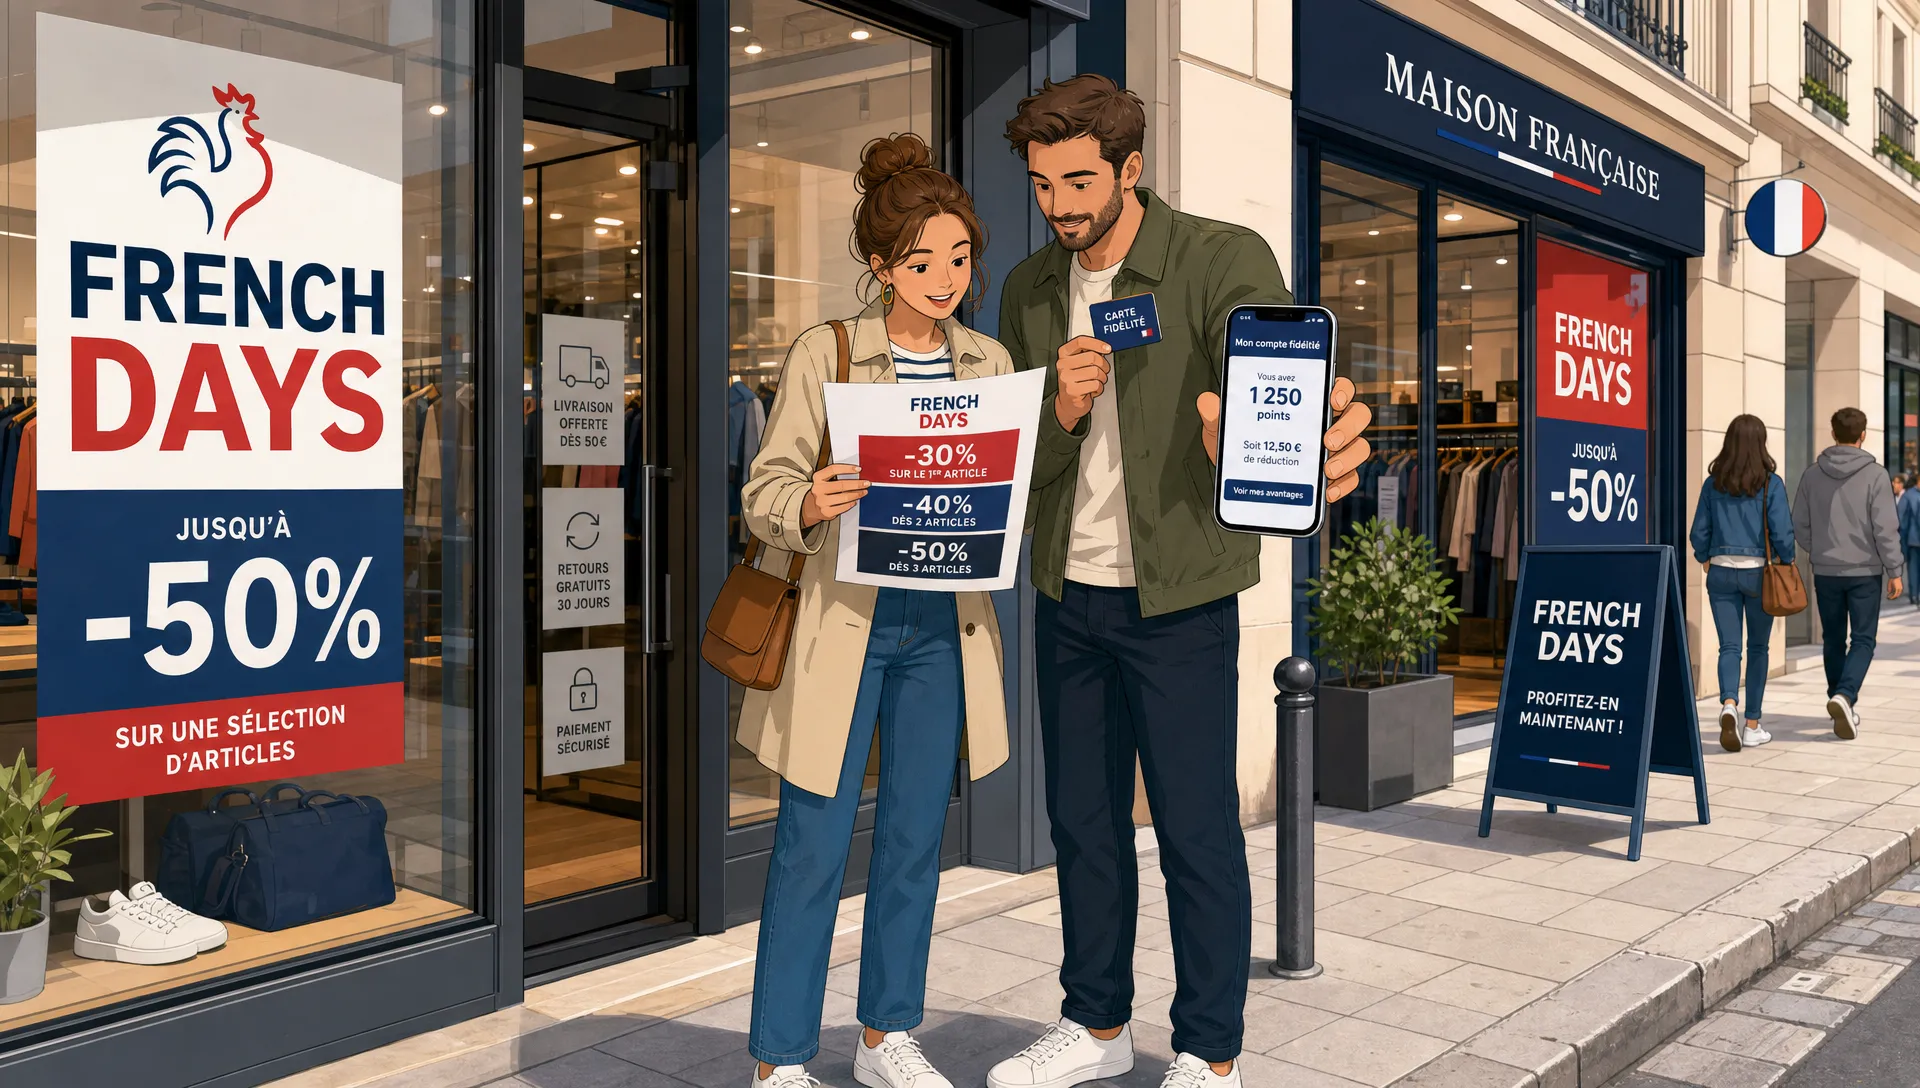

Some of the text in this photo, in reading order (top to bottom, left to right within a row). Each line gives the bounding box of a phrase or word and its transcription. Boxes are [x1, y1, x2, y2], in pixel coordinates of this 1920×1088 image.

[1384, 51, 1660, 200] MAISON FRANÇAISE
[70, 240, 385, 336] FRENCH
[1104, 307, 1137, 321] CARTE
[1103, 315, 1146, 334] FIDÉLITÉ
[1555, 311, 1632, 357] FRENCH
[1235, 338, 1254, 347] Mon
[1255, 340, 1288, 350] compte
[1257, 372, 1296, 382] Vous avez
[1555, 350, 1632, 406] DAYS
[70, 336, 384, 453] DAYS
[910, 394, 979, 412] FRENCH
[554, 400, 613, 413] LIVRAISON
[1257, 409, 1291, 421] points
[559, 417, 608, 430] OFFERTE
[919, 412, 968, 429] DAYS
[904, 443, 977, 466] -30%
[1243, 440, 1302, 453] Soit 12,50 €
[1572, 442, 1618, 462] JUSQU’À
[1243, 454, 1299, 466] de réduction
[889, 469, 911, 479] SUR
[913, 470, 926, 479] LE
[943, 468, 988, 479] ARTICLE
[1233, 486, 1304, 500] Voir mes avantages
[1551, 468, 1638, 522] -50%
[902, 494, 972, 515] -40%
[176, 509, 292, 542] JUSQU’À
[915, 517, 922, 526] 2
[924, 517, 976, 527] ARTICLES
[898, 541, 968, 562] -50%
[558, 562, 609, 576] RETOURS
[912, 563, 919, 573] 3
[921, 564, 972, 574] ARTICLES
[556, 579, 611, 593] GRATUITS
[557, 596, 610, 611] 30 JOURS
[85, 556, 381, 677] -50%
[1533, 599, 1642, 628] FRENCH
[1537, 631, 1625, 665] DAYS
[1526, 690, 1620, 712] PROFITEZ-EN
[115, 704, 346, 749] SUR UNE SÉLECTION
[556, 720, 612, 737] PAIEMENT
[1519, 711, 1615, 733] MAINTENANT
[557, 735, 610, 755] SÉCURISÉ
[166, 740, 295, 775] D’ARTICLES
